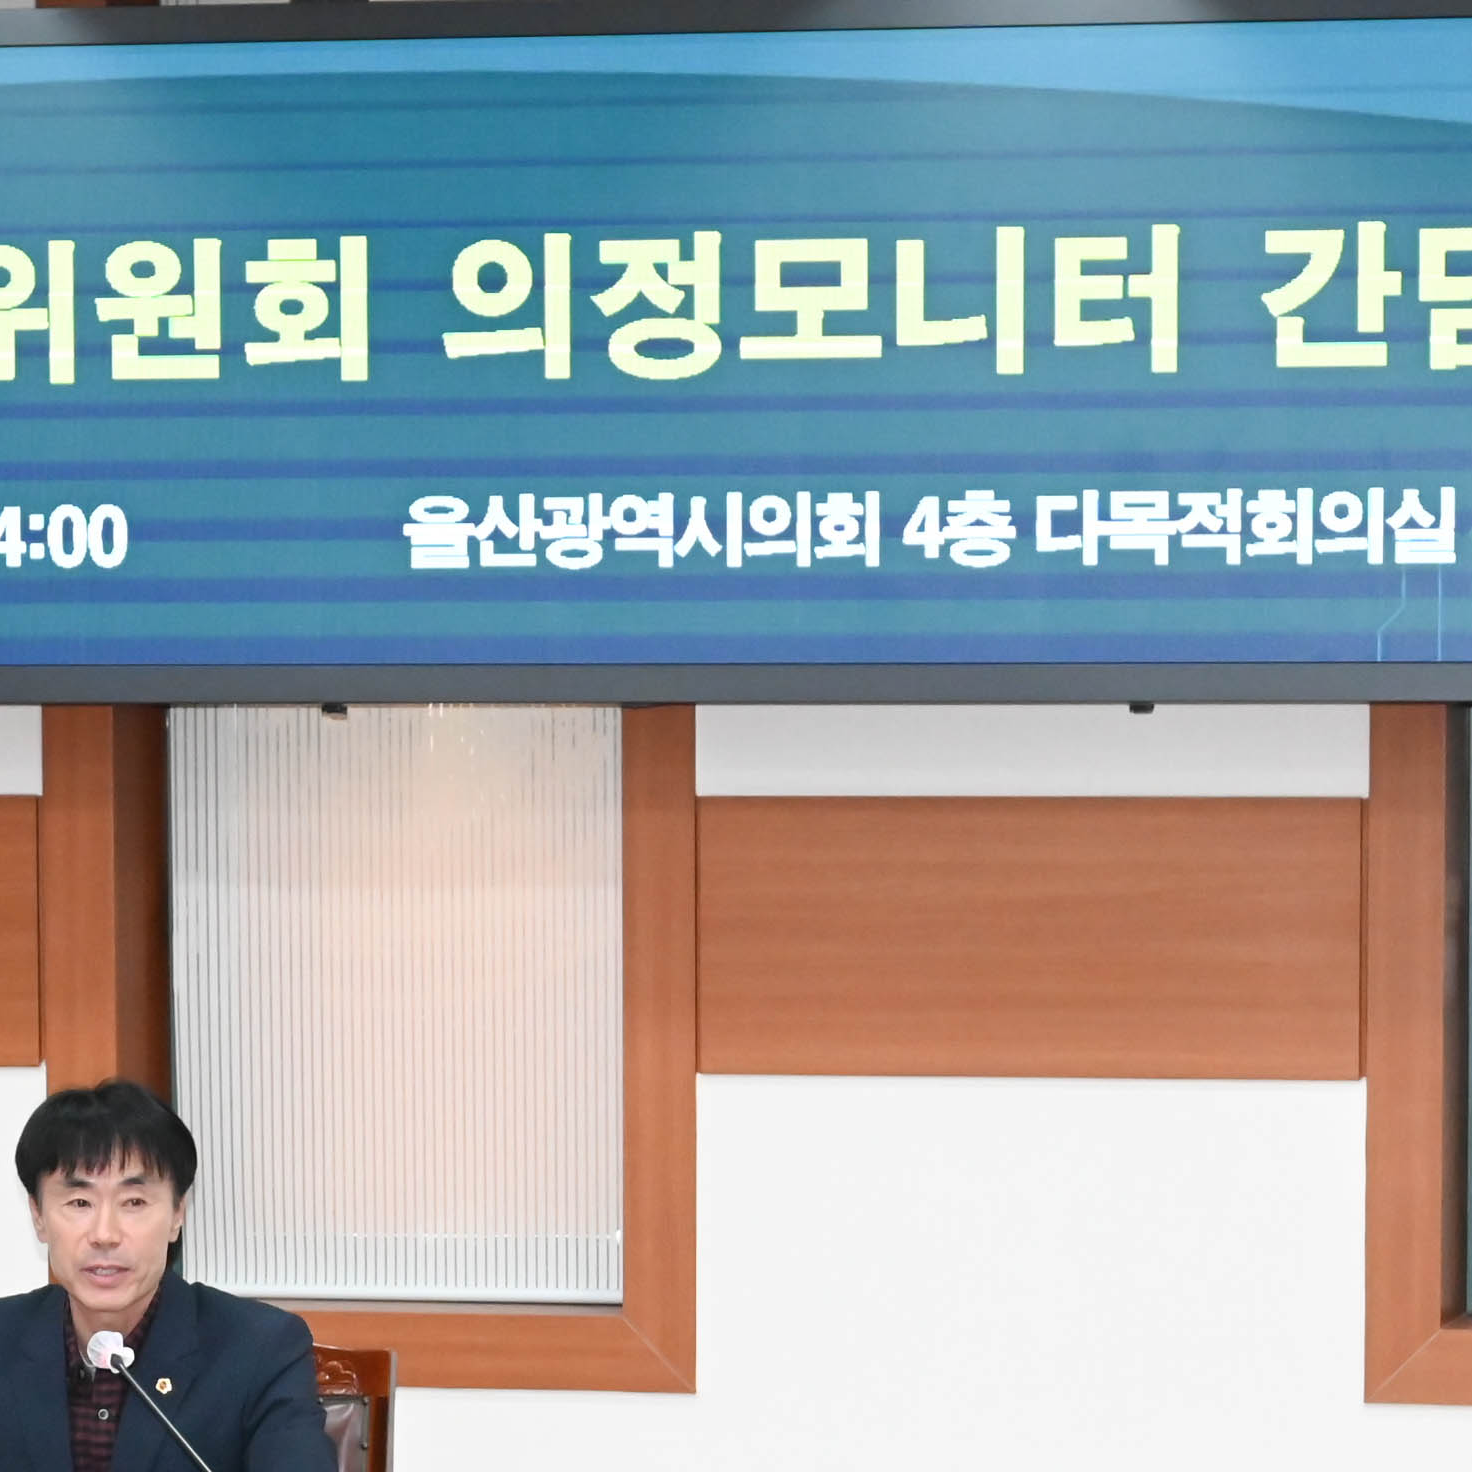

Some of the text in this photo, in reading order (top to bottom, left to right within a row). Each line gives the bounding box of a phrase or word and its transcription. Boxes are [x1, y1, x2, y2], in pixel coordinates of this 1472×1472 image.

[442, 223, 1182, 382] 의정모니터
[402, 485, 1458, 571] 울산광역시의회 4층 다목적회의실
